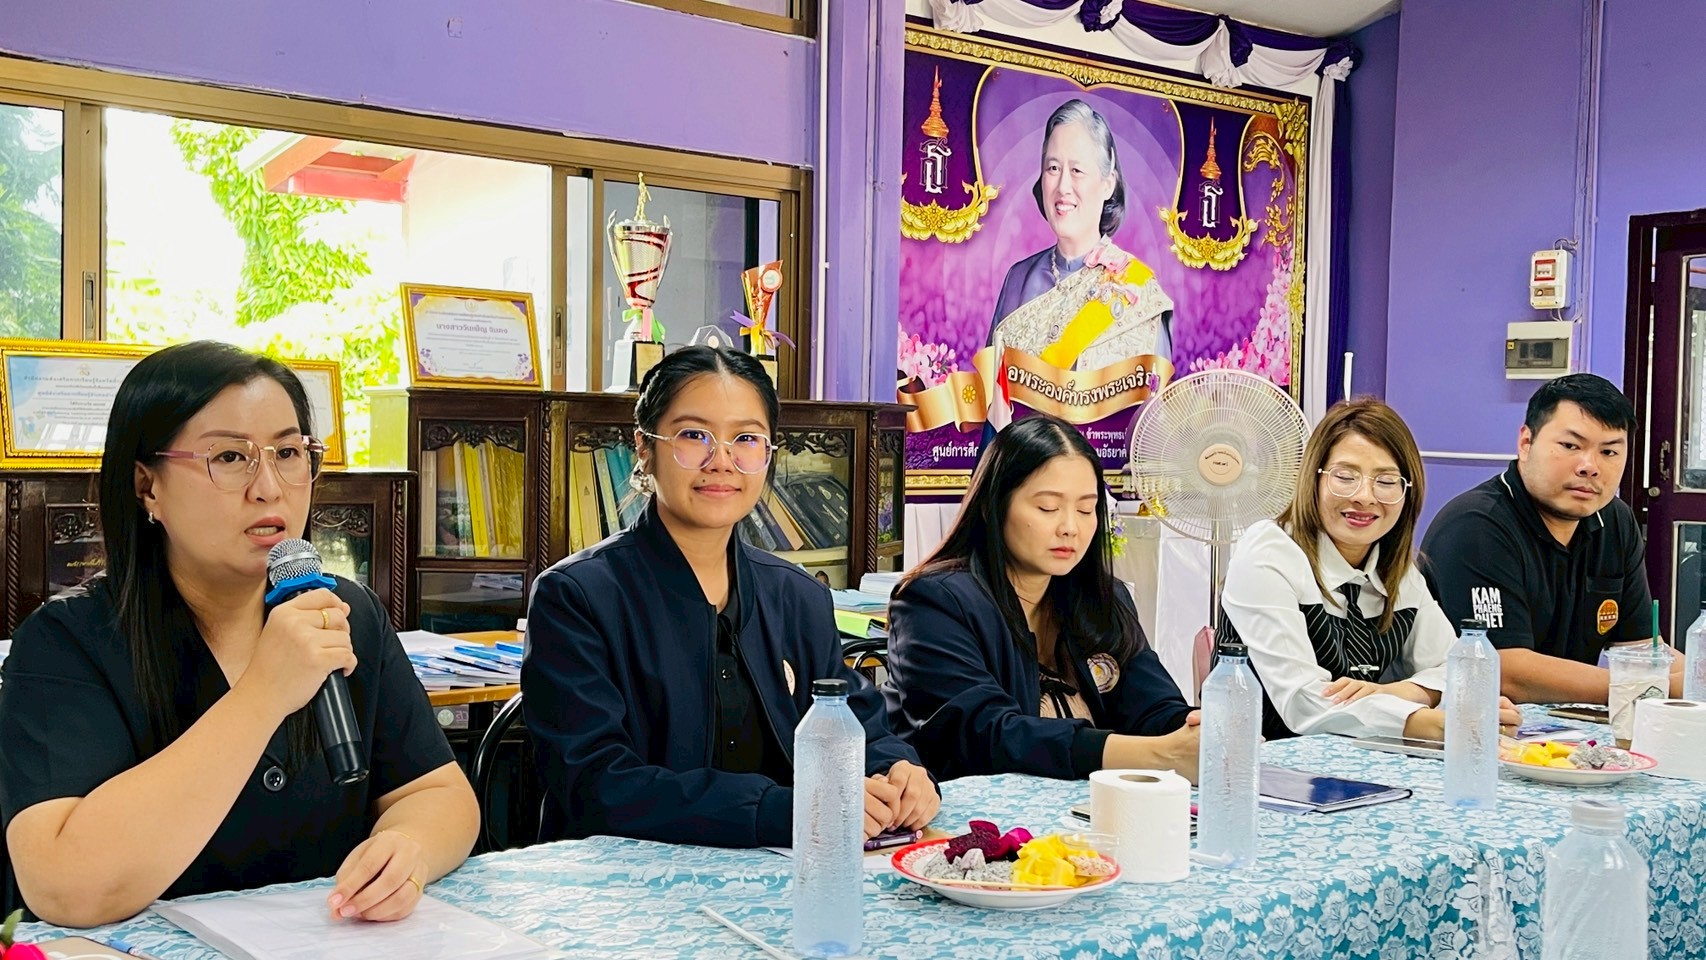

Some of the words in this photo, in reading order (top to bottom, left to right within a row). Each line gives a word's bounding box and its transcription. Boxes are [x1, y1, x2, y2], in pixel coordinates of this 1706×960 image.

[1007, 364, 1159, 406] อพระองค์ทรงพระเจริ
[1086, 427, 1128, 443] ข้าพระพุทธเ
[1471, 586, 1501, 604] KAM
[1473, 603, 1503, 614] PHAENG
